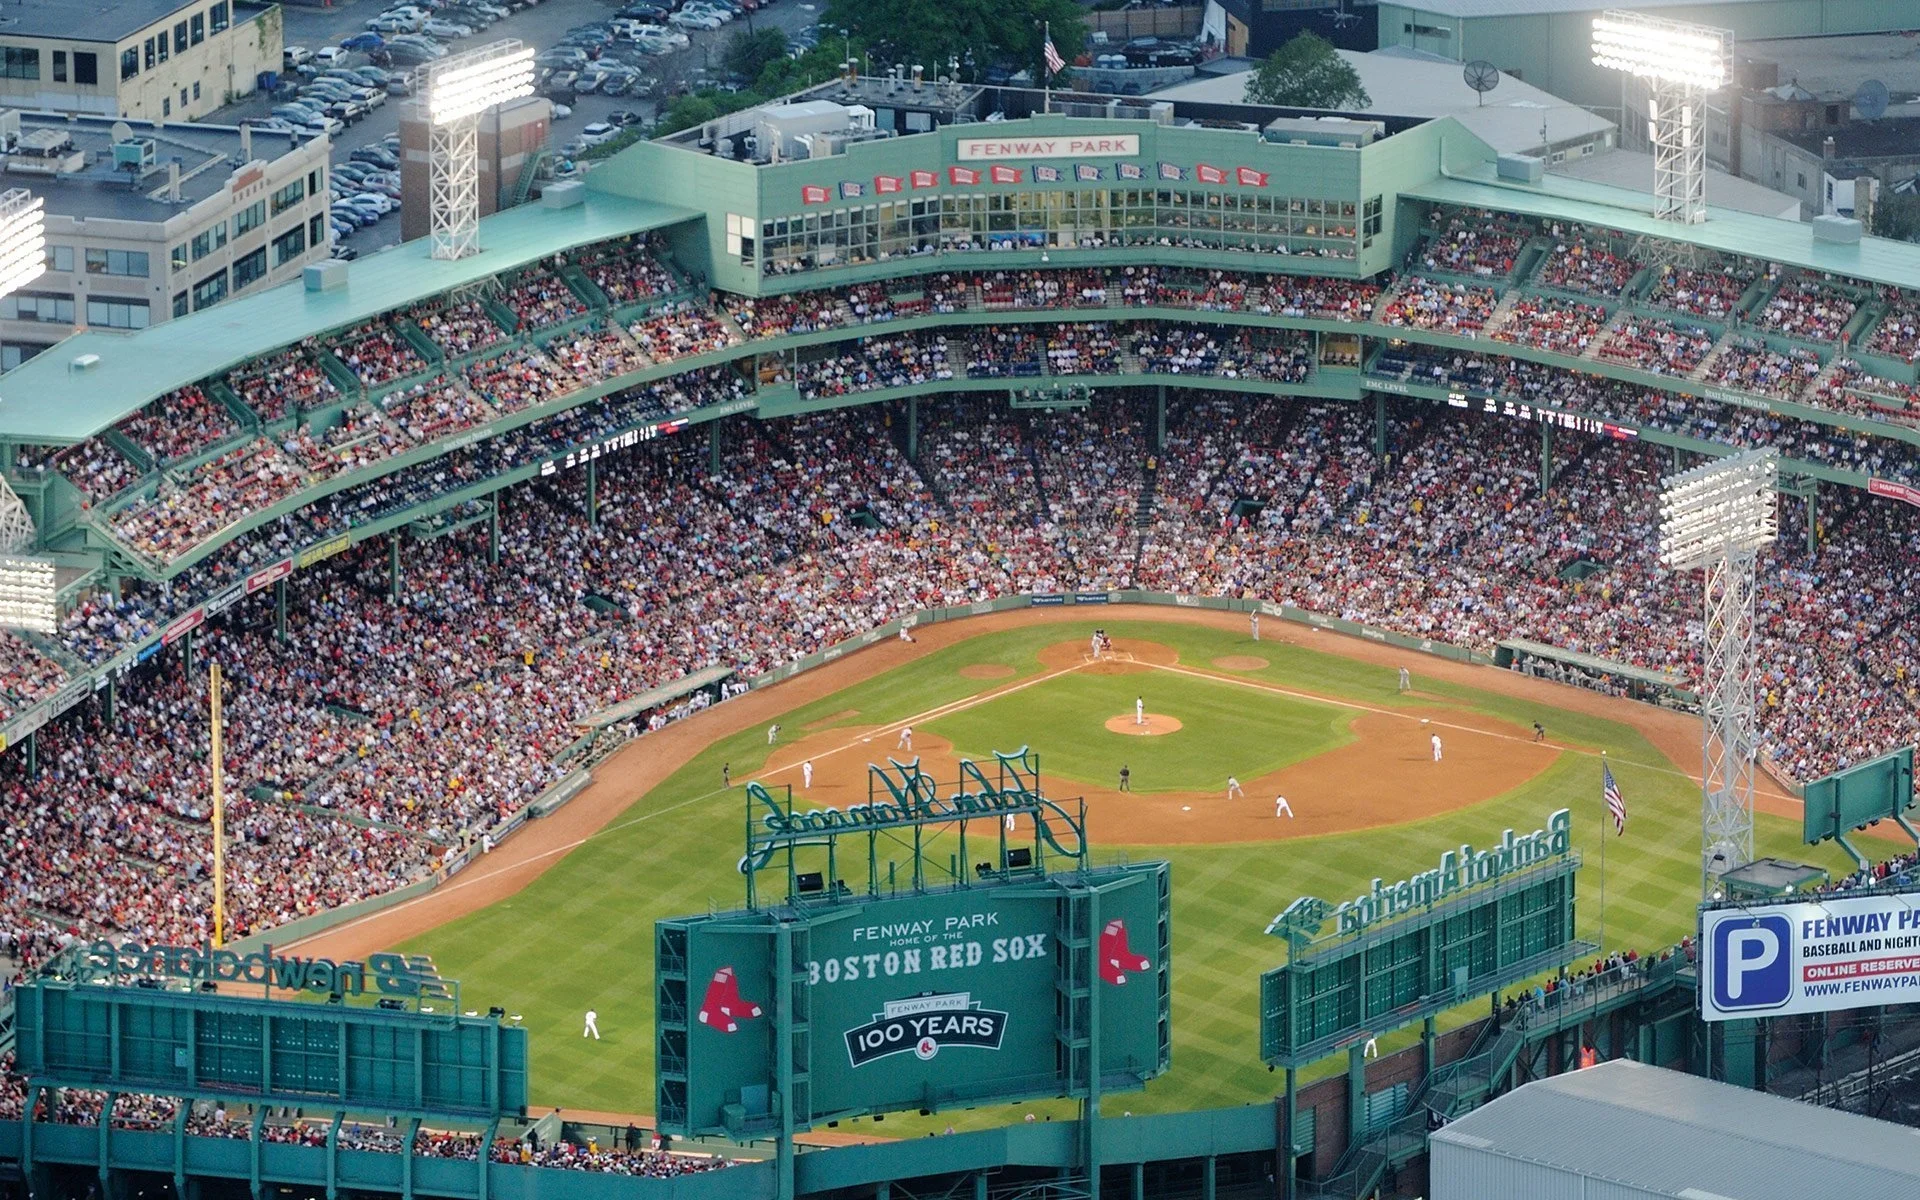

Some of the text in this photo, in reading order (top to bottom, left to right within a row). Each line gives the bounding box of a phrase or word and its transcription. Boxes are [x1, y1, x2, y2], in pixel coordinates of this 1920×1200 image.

[970, 139, 1127, 156] FENWAY PARK
[1384, 383, 1408, 393] LEVEL
[853, 912, 999, 942] FENWAY PARK
[1802, 912, 1892, 940] FENWAY
[889, 931, 963, 947] HOME OF THE
[1802, 935, 1920, 958] BASEBALL AND NIGHT
[805, 933, 1048, 986] BOSTON RED SOX
[1727, 928, 1779, 1000] P
[1807, 963, 1857, 978] ONLINE
[1804, 976, 1920, 997] WWW.FENWAYPA
[890, 999, 963, 1014] FENWAY PARK
[858, 1016, 994, 1052] 100 YEARS
